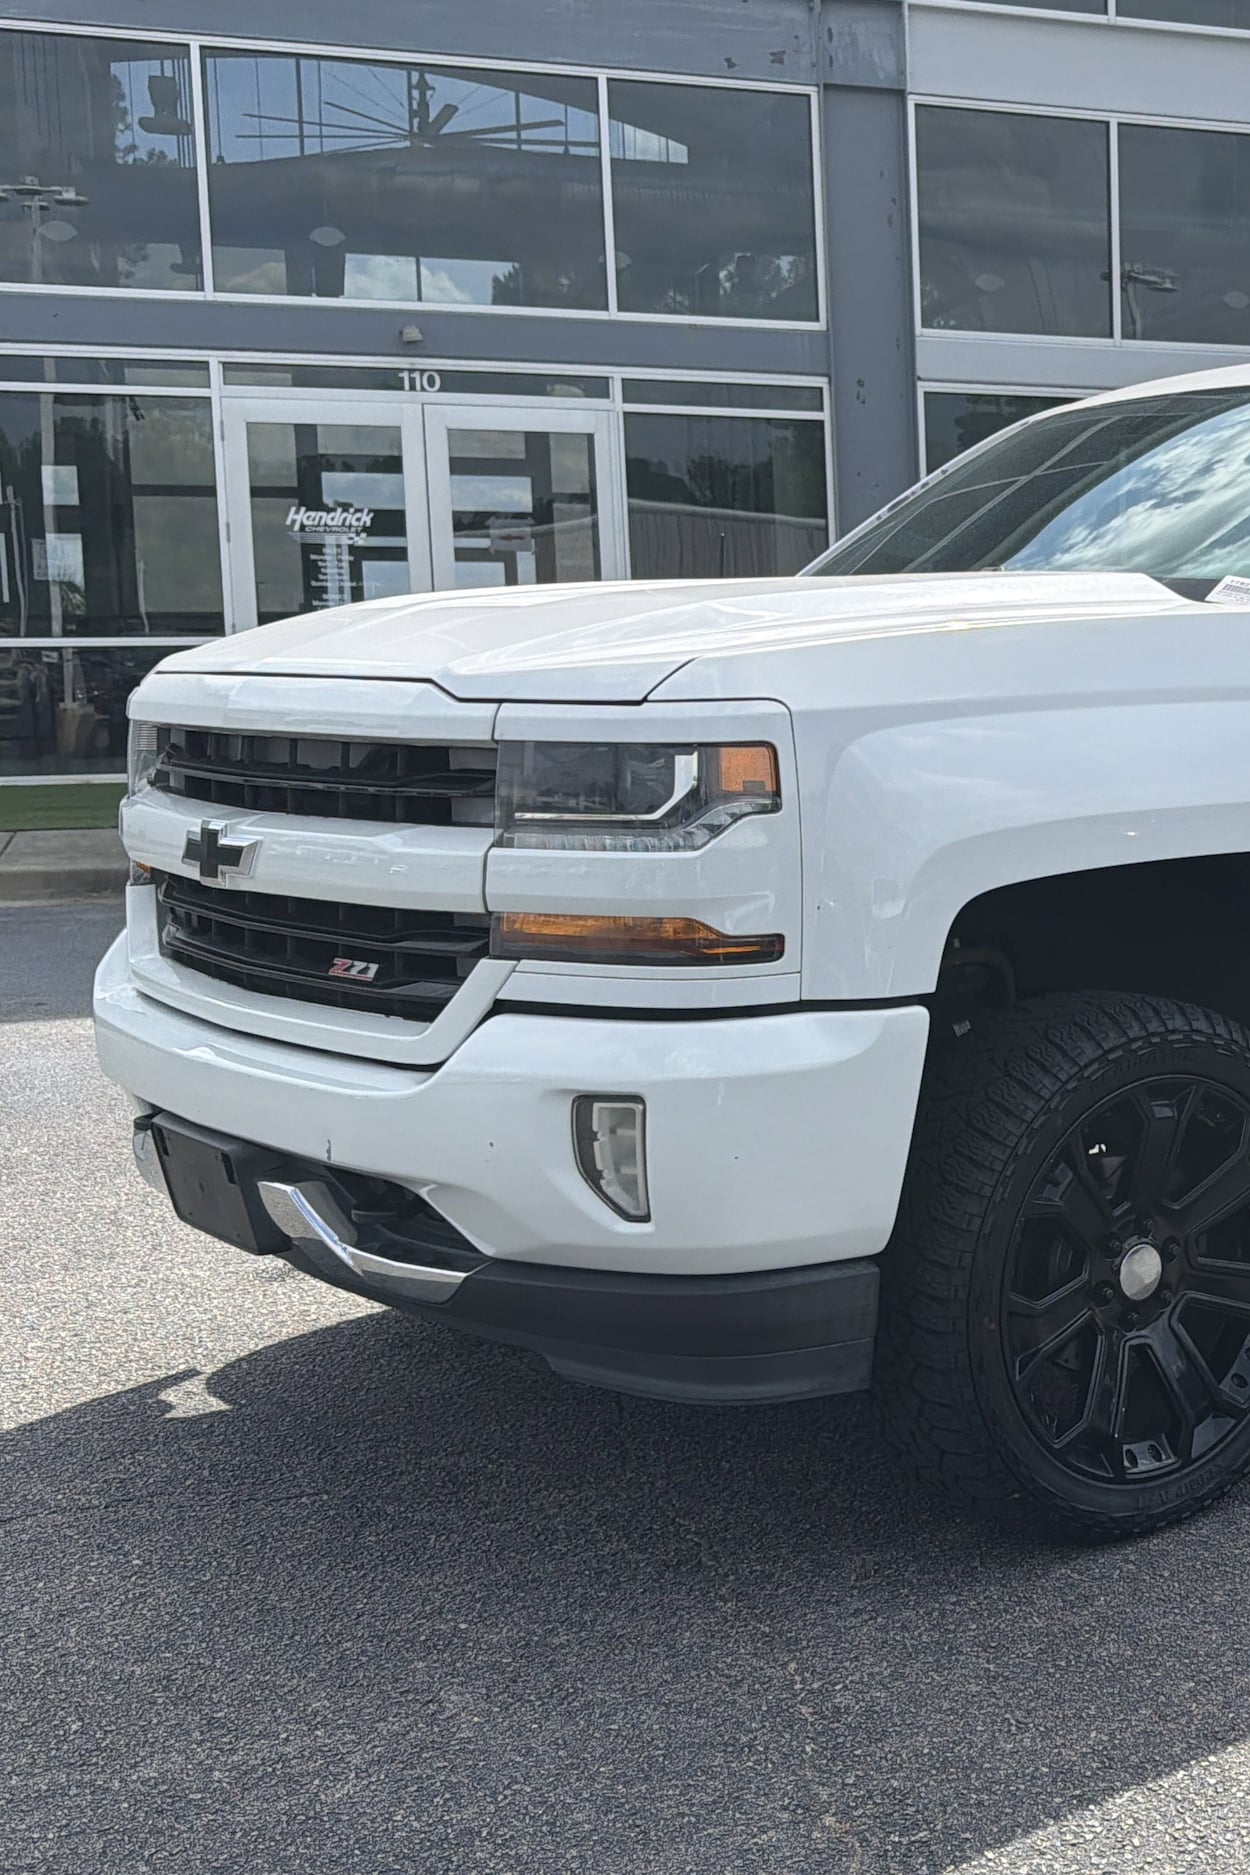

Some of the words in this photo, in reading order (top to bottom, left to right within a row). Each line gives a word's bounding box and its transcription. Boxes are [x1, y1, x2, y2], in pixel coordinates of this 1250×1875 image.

[398, 370, 441, 392] 110
[285, 506, 375, 531] Hendrick
[328, 957, 380, 981] Z71
